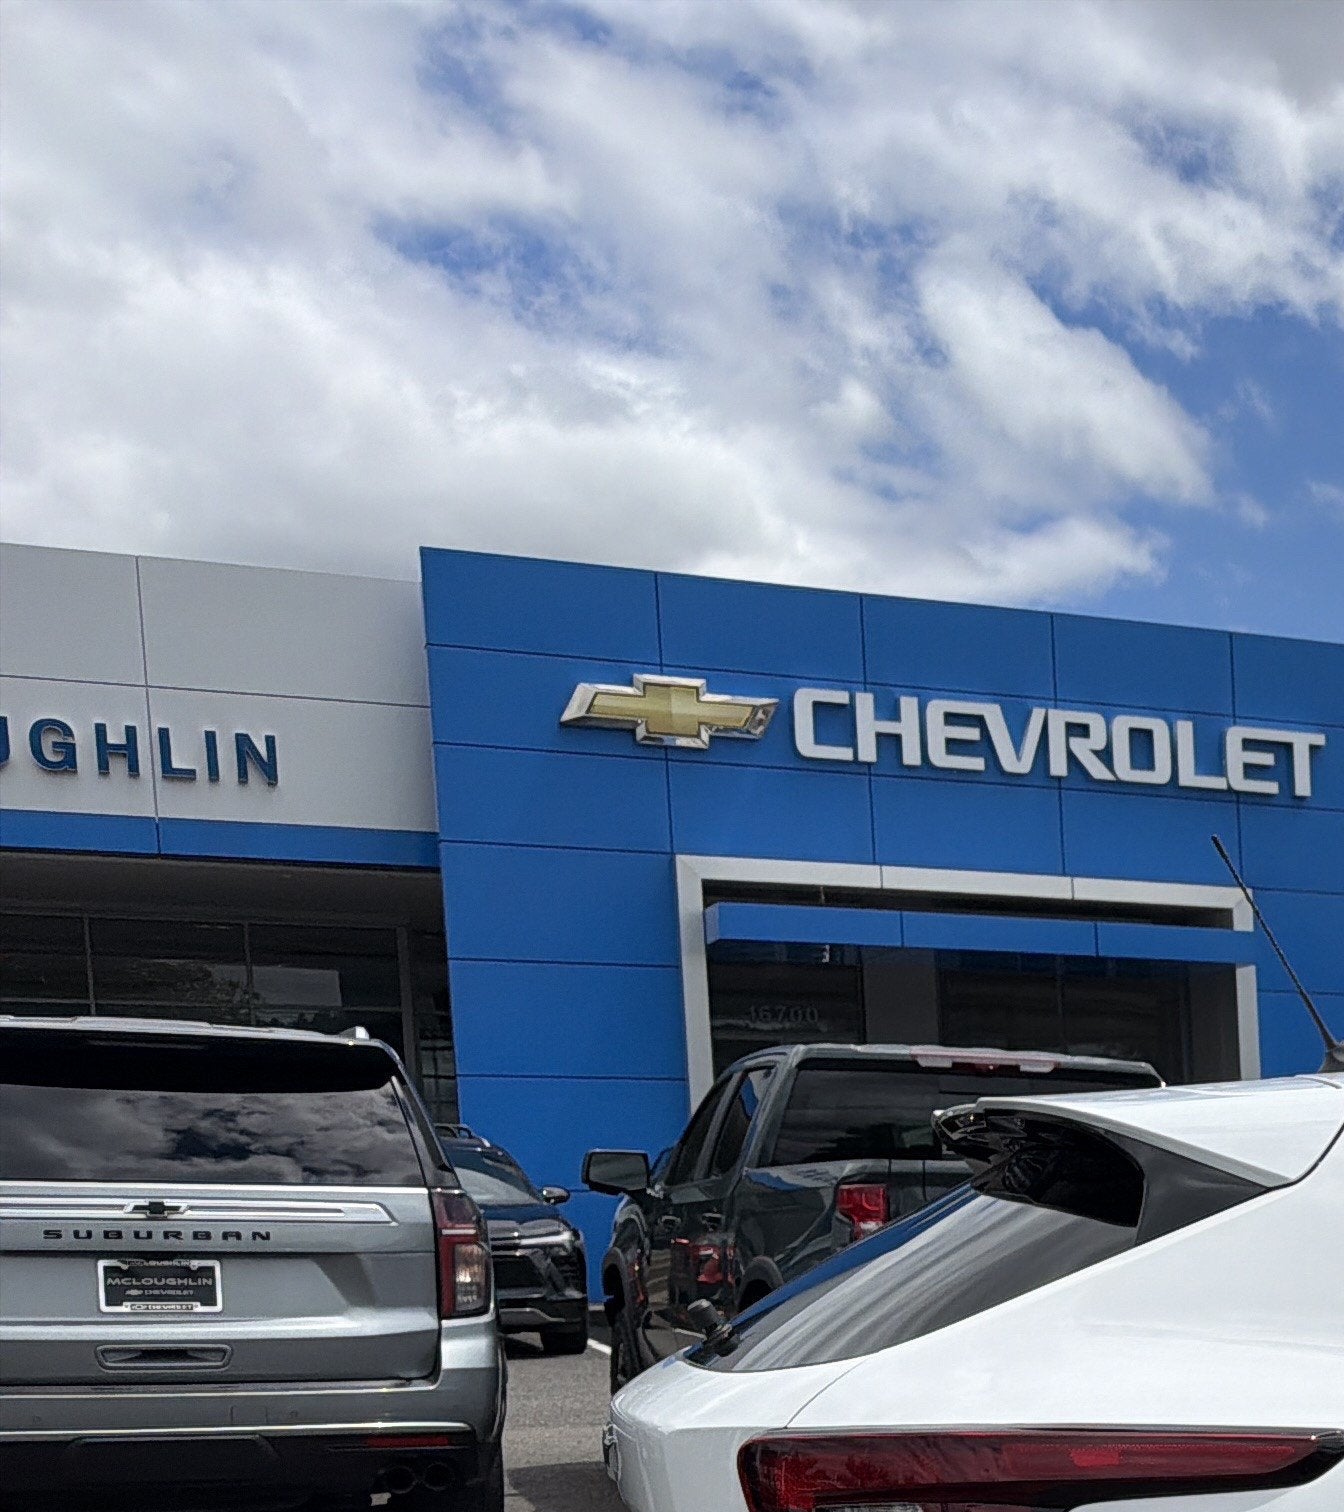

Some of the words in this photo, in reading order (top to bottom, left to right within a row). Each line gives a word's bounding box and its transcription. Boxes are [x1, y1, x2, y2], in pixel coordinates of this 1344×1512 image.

[0, 705, 280, 788] GHLIN
[793, 687, 1327, 798] CHEVROLET
[42, 1228, 272, 1242] SUBURBAN
[106, 1277, 214, 1287] MCLOUGHLIN
